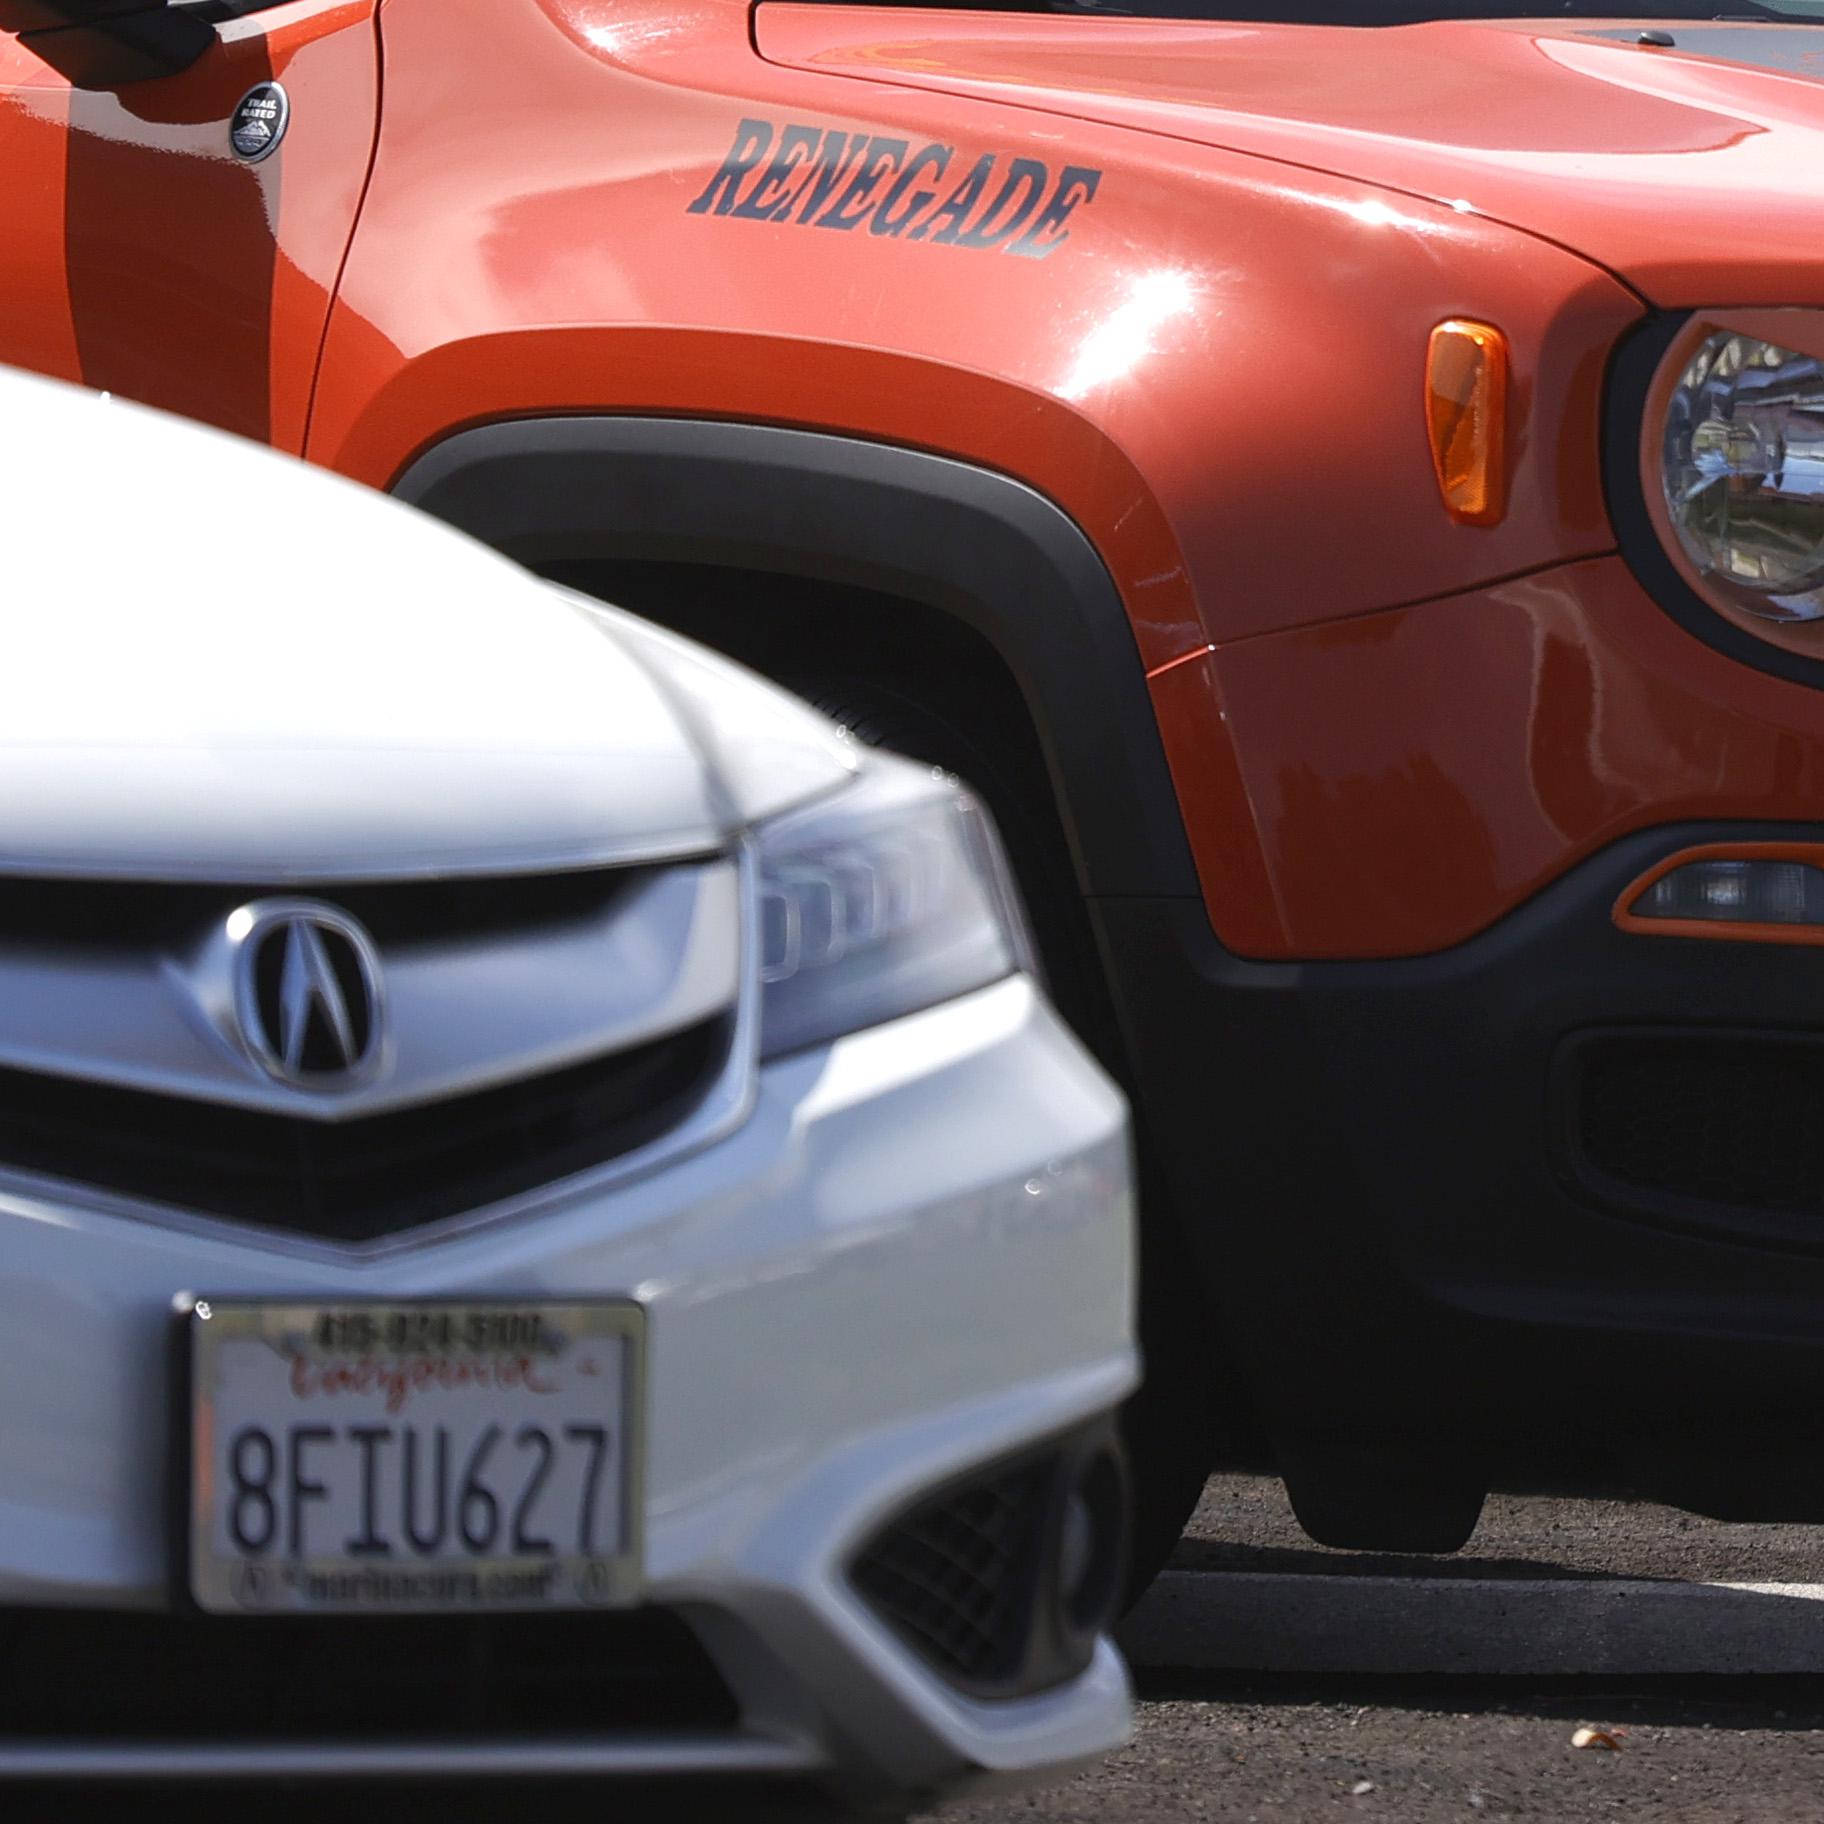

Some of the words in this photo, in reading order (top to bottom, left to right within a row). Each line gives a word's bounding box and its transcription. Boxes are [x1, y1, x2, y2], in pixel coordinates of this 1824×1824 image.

[240, 108, 276, 119] RATED
[247, 98, 277, 110] TRAIL
[687, 118, 1103, 260] RENEGADE
[228, 1424, 611, 1557] 8FIU627
